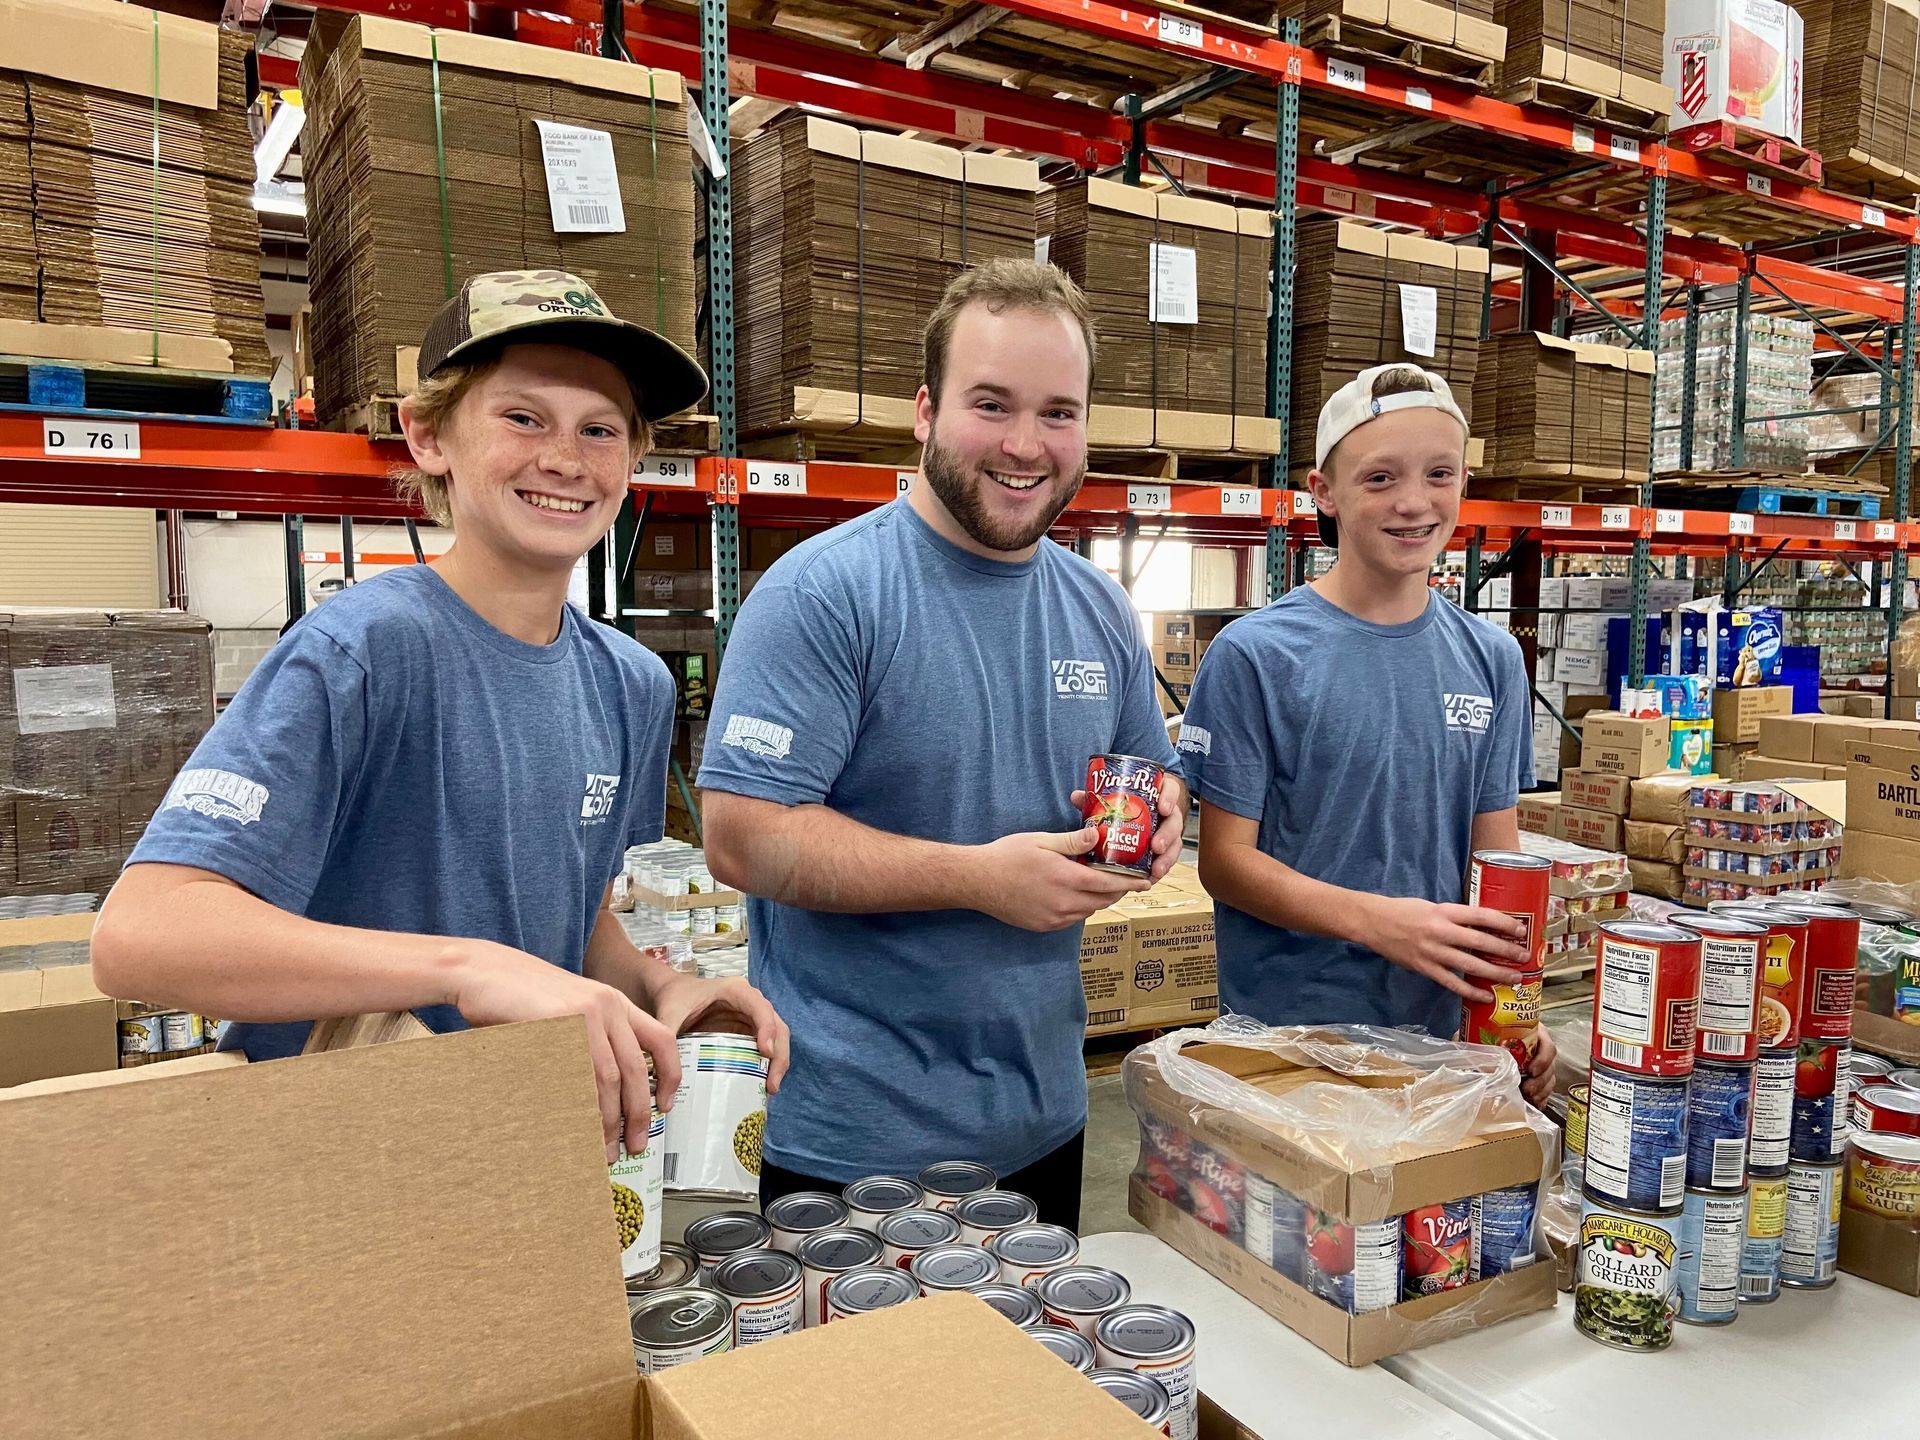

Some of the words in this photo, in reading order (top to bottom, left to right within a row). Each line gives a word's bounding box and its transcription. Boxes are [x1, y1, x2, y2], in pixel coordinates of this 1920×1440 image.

[1162, 18, 1169, 30] D
[1179, 22, 1191, 36] 89
[1329, 66, 1336, 77] D
[1343, 69, 1355, 82] 88
[1612, 138, 1618, 148] D
[1623, 140, 1632, 151] 87
[48, 430, 65, 447] D
[86, 432, 113, 449] 76
[659, 463, 677, 476] 59
[750, 472, 760, 485] D
[774, 474, 790, 487] 58
[900, 480, 908, 491] D
[1129, 493, 1137, 504] D
[1146, 493, 1159, 505] 73
[1223, 493, 1230, 504] D
[1239, 493, 1250, 504] 57
[1296, 497, 1302, 508] D
[1543, 511, 1548, 520] D
[1555, 511, 1563, 521] 71
[1603, 514, 1608, 523] D
[1614, 515, 1622, 523] 55
[1658, 514, 1662, 522] D
[1668, 515, 1675, 523] 54
[1731, 521, 1735, 529] D
[1741, 521, 1747, 529] 70
[1836, 524, 1840, 532] D
[1876, 527, 1880, 535] D
[1602, 752, 1619, 761] DICED
[1595, 760, 1625, 770] TOMATOES
[1911, 765, 1919, 781] S
[1092, 769, 1132, 793] Vine
[1570, 781, 1584, 792] LION
[1589, 783, 1611, 796] BRAND
[1878, 783, 1920, 806] BARTL
[1527, 810, 1547, 822] BRAND
[1895, 808, 1903, 818] IN
[1564, 817, 1579, 828] LION
[1583, 820, 1605, 833] BRAND
[1107, 826, 1140, 846] Diced
[1107, 842, 1136, 853] tomatoes
[1105, 924, 1128, 935] 10615
[1135, 929, 1154, 939] BEST
[1156, 927, 1169, 937] BY:
[1170, 925, 1200, 935] JUL2622
[1082, 937, 1091, 945] 22
[1092, 934, 1124, 944] C221914
[1142, 937, 1180, 949] DEHYDRATED
[1181, 935, 1201, 945] POTATO
[1096, 946, 1118, 956] FLAKES
[1606, 945, 1630, 958] Nutrition
[1631, 950, 1650, 961] Facts
[1706, 942, 1736, 953] Nutrition
[1138, 963, 1161, 971] USDA
[1705, 966, 1735, 974] Calories
[1138, 972, 1161, 980] FOOD
[1605, 969, 1628, 980] Calories
[1638, 975, 1650, 983] 50
[1614, 1081, 1632, 1090] Facts
[1620, 1105, 1631, 1115] 25
[1804, 1172, 1821, 1180] Facts
[1865, 1168, 1886, 1186] Chef
[1706, 1201, 1732, 1209] Nutrition
[1865, 1194, 1915, 1213] SAUCE
[1471, 1209, 1481, 1218] 25
[1423, 1216, 1469, 1246] Vine
[1588, 1220, 1631, 1234] MARGARET
[1632, 1227, 1667, 1247] HOLMES
[1587, 1249, 1662, 1277] COLLARD
[1591, 1265, 1656, 1290] GREENS
[746, 1305, 774, 1315] Condensed
[739, 1316, 771, 1324] Nutrition
[772, 1310, 790, 1320] Facts
[1173, 1374, 1189, 1384] Facts
